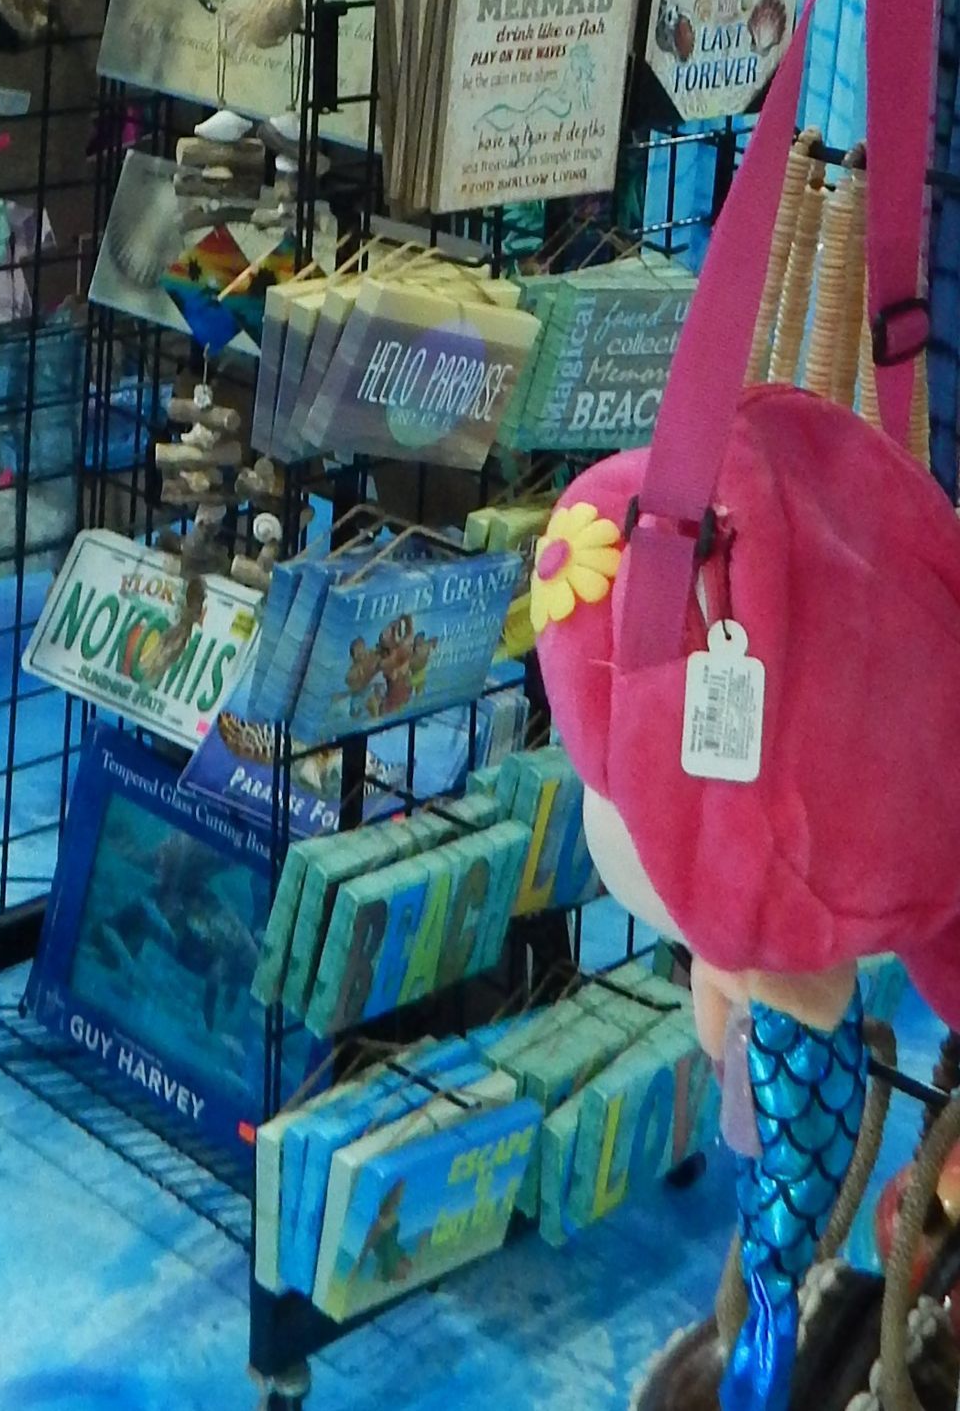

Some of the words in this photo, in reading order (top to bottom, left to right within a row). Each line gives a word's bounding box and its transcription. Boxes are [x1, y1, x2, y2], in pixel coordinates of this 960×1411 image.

[495, 23, 535, 44] drink
[537, 22, 562, 39] like
[565, 25, 578, 38] a
[700, 22, 748, 53] LAST
[470, 50, 498, 68] PLAY
[499, 49, 513, 64] ON
[515, 47, 534, 62] THE
[536, 43, 568, 60] WAVES
[673, 56, 759, 94] FOREVER
[477, 130, 505, 152] have
[565, 117, 607, 147] depths
[551, 167, 588, 185] LIVING
[593, 297, 674, 343] found
[605, 330, 683, 356] collect
[356, 340, 427, 407] HELLO
[419, 351, 514, 423] PARADISE
[567, 388, 664, 432] BEAC
[119, 572, 176, 607] FLOR
[413, 584, 435, 610] IS
[101, 747, 159, 797] Tempered
[159, 784, 193, 815] Glass
[195, 801, 243, 848] Cutting
[246, 835, 272, 860] Boa
[229, 764, 306, 815] PARAISE
[69, 1013, 114, 1060] GUY
[117, 1046, 206, 1121] HARVEY
